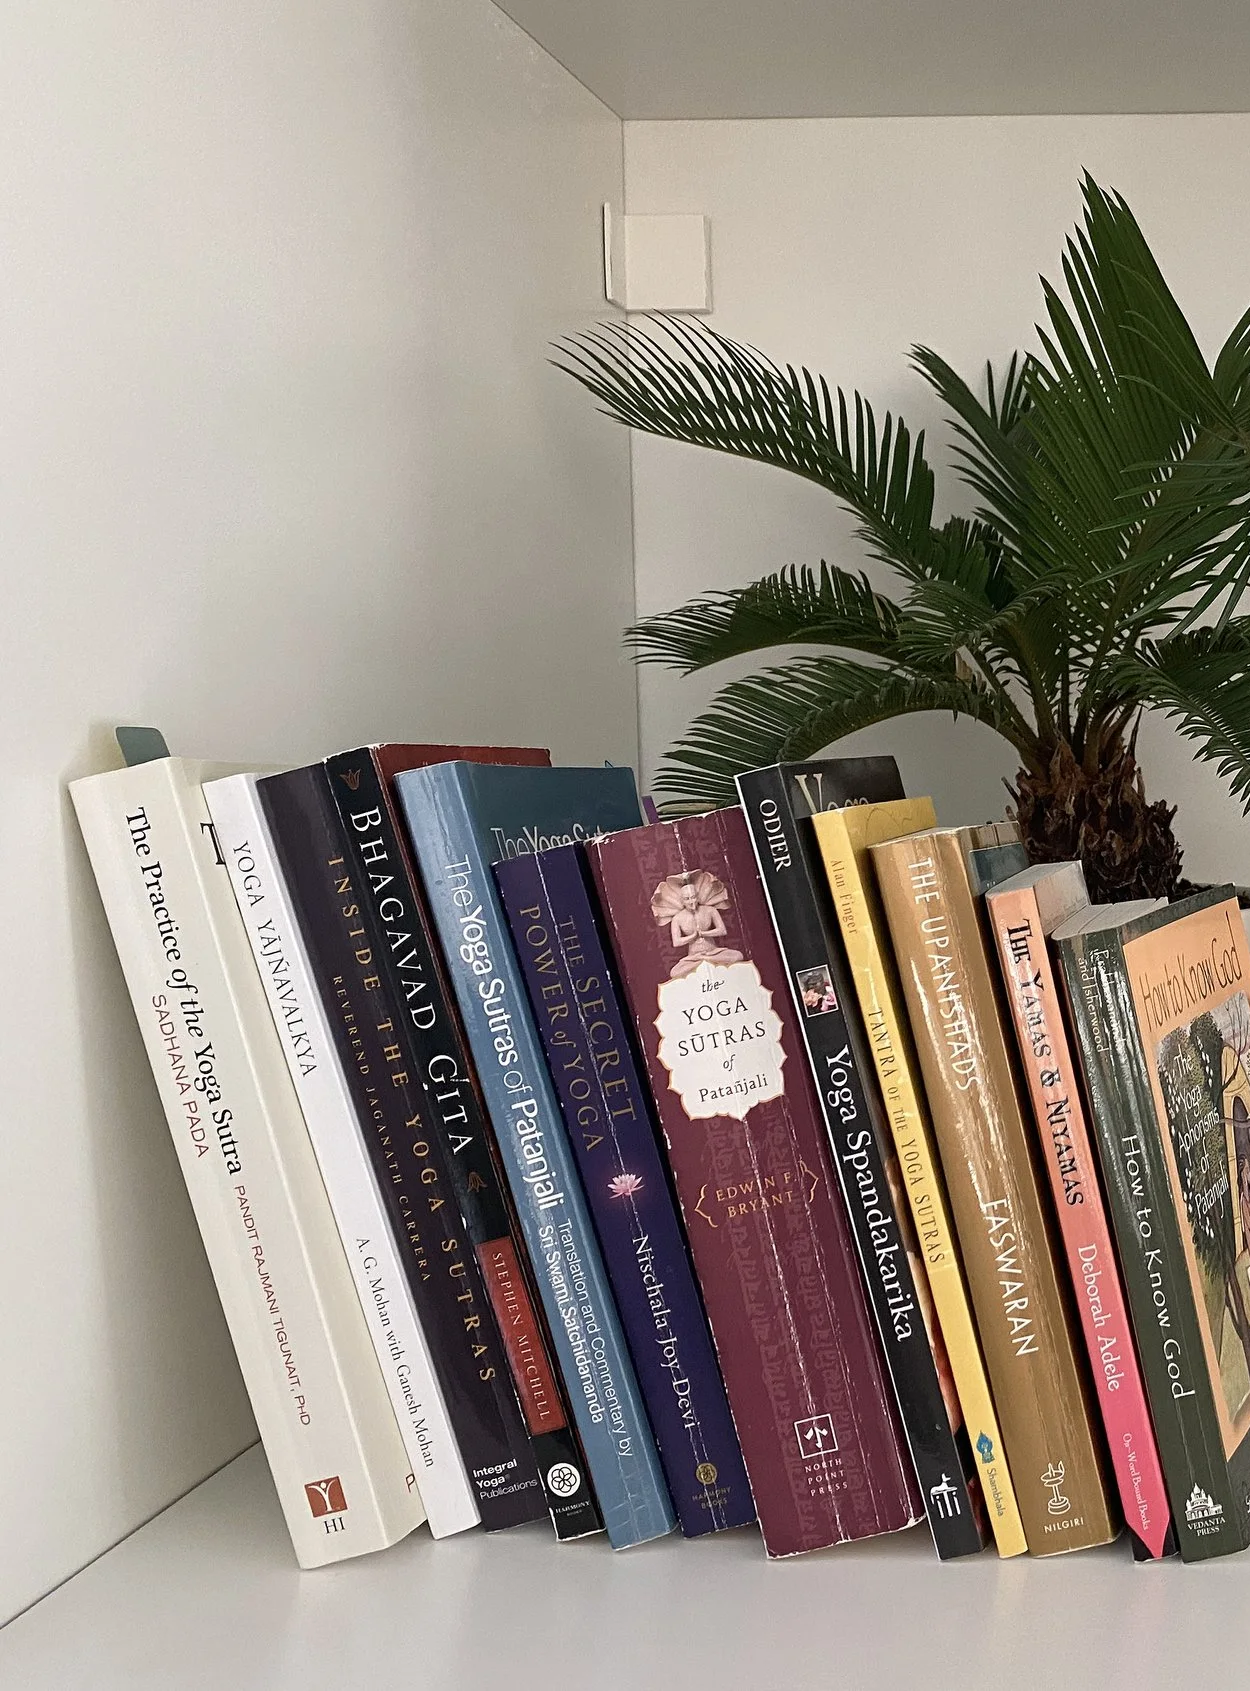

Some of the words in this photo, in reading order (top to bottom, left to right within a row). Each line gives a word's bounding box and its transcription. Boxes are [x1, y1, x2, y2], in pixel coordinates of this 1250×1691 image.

[126, 807, 153, 856] The
[759, 798, 791, 872] ODIER
[233, 841, 265, 907] YOGA
[445, 854, 474, 909] The
[907, 857, 939, 905] THE
[141, 860, 182, 962] Practice
[840, 893, 859, 937] Finger
[459, 907, 493, 977] Yoga
[166, 968, 200, 996] of
[350, 805, 435, 1030] BHAGAVAD
[427, 1055, 474, 1156] GITA
[701, 979, 724, 994] the
[1078, 957, 1093, 981] and
[1139, 972, 1169, 1031] How
[1164, 964, 1182, 1017] to
[1178, 953, 1214, 1009] Know
[1211, 911, 1241, 988] God
[178, 997, 205, 1039] the
[478, 978, 518, 1066] Sutras
[519, 905, 570, 1024] POWER
[551, 1029, 575, 1047] of
[563, 1052, 603, 1151] YOGA
[560, 915, 585, 968] THE
[576, 974, 636, 1123] SECRET
[682, 997, 748, 1026] YOGA
[919, 916, 979, 1092] UPANISHADS
[1083, 983, 1109, 1054] Isherwood
[678, 1020, 767, 1057] SŪTRAS
[722, 1054, 735, 1072] of
[868, 1007, 897, 1079] TANTRA
[1175, 1045, 1194, 1078] The
[152, 995, 191, 1096] SADHANA
[183, 1101, 209, 1158] PADA
[194, 1042, 222, 1105] Yoga
[504, 1069, 532, 1095] of
[699, 1073, 768, 1103] Patañjali
[888, 1085, 899, 1103] OF
[1040, 1068, 1061, 1087] &
[327, 856, 381, 992] INSIDE
[376, 1017, 409, 1088] THE
[406, 1113, 445, 1211] YOGA
[442, 1239, 495, 1381] SUTRAS
[893, 1107, 907, 1132] THE
[1179, 1084, 1202, 1118] Yoga
[212, 1108, 243, 1175] Sutra
[332, 975, 370, 1077] REVEREND
[366, 1087, 402, 1185] JAGANATH
[399, 1196, 430, 1282] CARRERA
[511, 1098, 565, 1209] Patanjali
[901, 1137, 924, 1187] YOGA
[1201, 1137, 1210, 1173] of
[728, 1190, 794, 1218] BRYANT
[826, 1043, 858, 1125] Yoga
[842, 1129, 915, 1342] Spandakarika
[357, 1236, 370, 1252] A.
[538, 1225, 557, 1249] Sri
[915, 1194, 945, 1263] SUTRAS
[364, 1256, 377, 1274] G.
[546, 1250, 573, 1305] Swami
[557, 1220, 587, 1301] Translation
[983, 1199, 1038, 1358] EASWARAN
[1122, 1135, 1147, 1196] How
[1136, 1206, 1152, 1237] to
[1145, 1249, 1171, 1328] Know
[1163, 1339, 1195, 1399] God
[234, 1185, 260, 1240] PANDIT
[252, 1244, 279, 1314] RAJMANI
[273, 1317, 300, 1393] TIGUNAIT,
[293, 1396, 311, 1427] PHD
[369, 1278, 390, 1327] Mohan
[582, 1303, 599, 1333] and
[1078, 1243, 1112, 1328] Deborah
[1098, 1335, 1124, 1392] Adele
[385, 1330, 406, 1361] with
[492, 1252, 523, 1327] STEPHEN
[518, 1336, 551, 1421] MITCHELL
[632, 1234, 668, 1330] Nischala
[656, 1337, 680, 1371] Joy
[672, 1376, 698, 1430] Devi
[396, 1364, 420, 1415] Ganesh
[562, 1307, 603, 1423] Satchidananda
[590, 1337, 627, 1434] Commentary
[412, 1418, 434, 1468] Mohan
[619, 1437, 632, 1456] by
[804, 1458, 843, 1472] NORTH
[473, 1459, 517, 1478] Integral
[480, 1478, 537, 1500] Publications
[807, 1471, 844, 1485] POINT
[810, 1481, 849, 1496] PRESS
[986, 1468, 1004, 1517] Shambhala
[1132, 1475, 1147, 1503] Bound
[323, 1517, 345, 1534] HI
[1043, 1517, 1084, 1534] NILGIRI
[1139, 1502, 1151, 1531] Books
[1187, 1517, 1226, 1530] VEDANTA
[1196, 1527, 1220, 1537] PRESS
